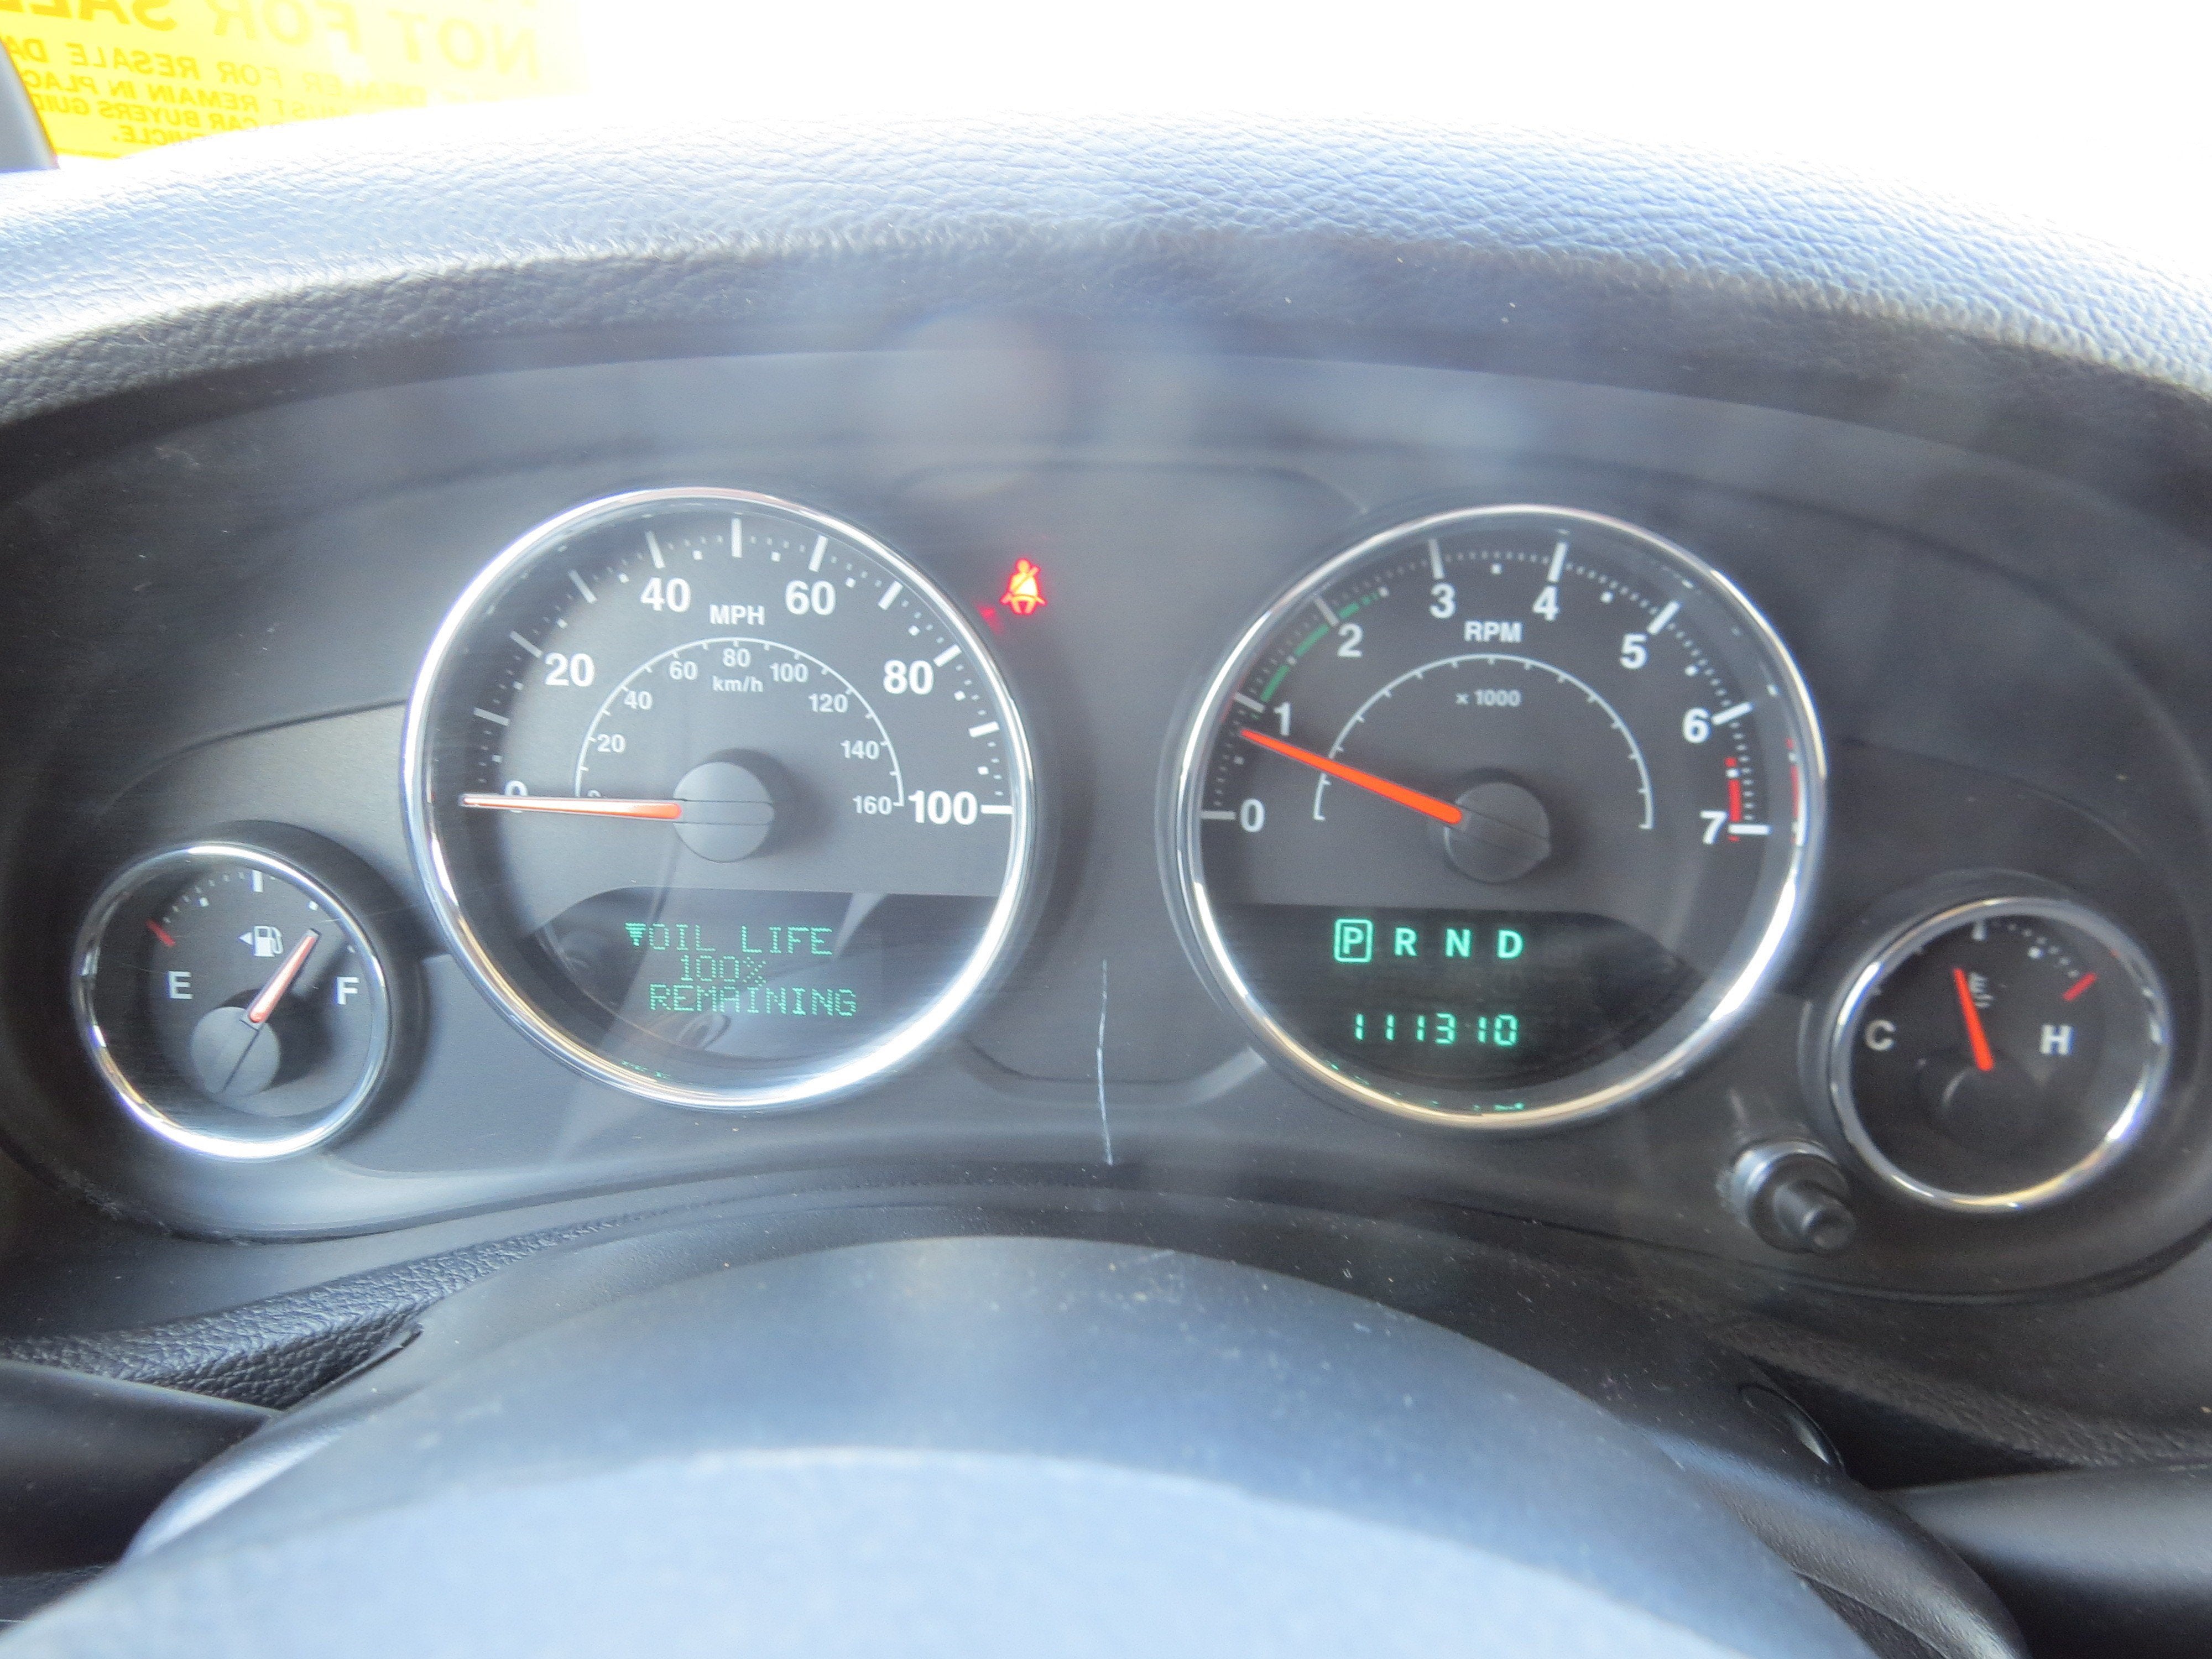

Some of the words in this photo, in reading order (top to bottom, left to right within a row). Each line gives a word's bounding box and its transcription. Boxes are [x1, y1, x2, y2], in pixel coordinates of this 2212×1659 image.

[640, 577, 691, 612] 40
[785, 580, 836, 615] 60
[1430, 583, 1455, 619] 3
[1533, 586, 1559, 621] 4
[709, 604, 765, 625] MPH
[1335, 620, 1363, 658] 2
[1464, 620, 1522, 643] RPM
[722, 647, 751, 667] 80
[1620, 634, 1646, 669] 5
[545, 653, 595, 687] 20
[669, 660, 698, 680] 60
[712, 675, 763, 692] km/h
[770, 662, 808, 682] 100
[883, 660, 935, 695] 80
[622, 687, 653, 710] 40
[808, 693, 850, 713] 120
[1474, 689, 1521, 707] 1000
[1274, 702, 1291, 735] 1
[1683, 708, 1710, 743] 6
[595, 733, 625, 753] 20
[841, 740, 882, 760] 140
[853, 795, 893, 815] 160
[907, 790, 978, 825] 100
[1241, 799, 1265, 832] 0
[1700, 810, 1728, 844] 7
[648, 923, 716, 952] OIL
[740, 926, 833, 956] LIFE
[1343, 926, 1365, 954] P
[1395, 927, 1418, 956] R
[1446, 928, 1470, 957] N
[1498, 930, 1522, 958] D
[169, 971, 192, 999] E
[680, 954, 766, 987] 100%
[337, 977, 359, 1005] F
[649, 983, 857, 1017] REMAINING
[1355, 1013, 1517, 1046] 111310
[1866, 1020, 1895, 1051] C
[2041, 1025, 2071, 1055] H
